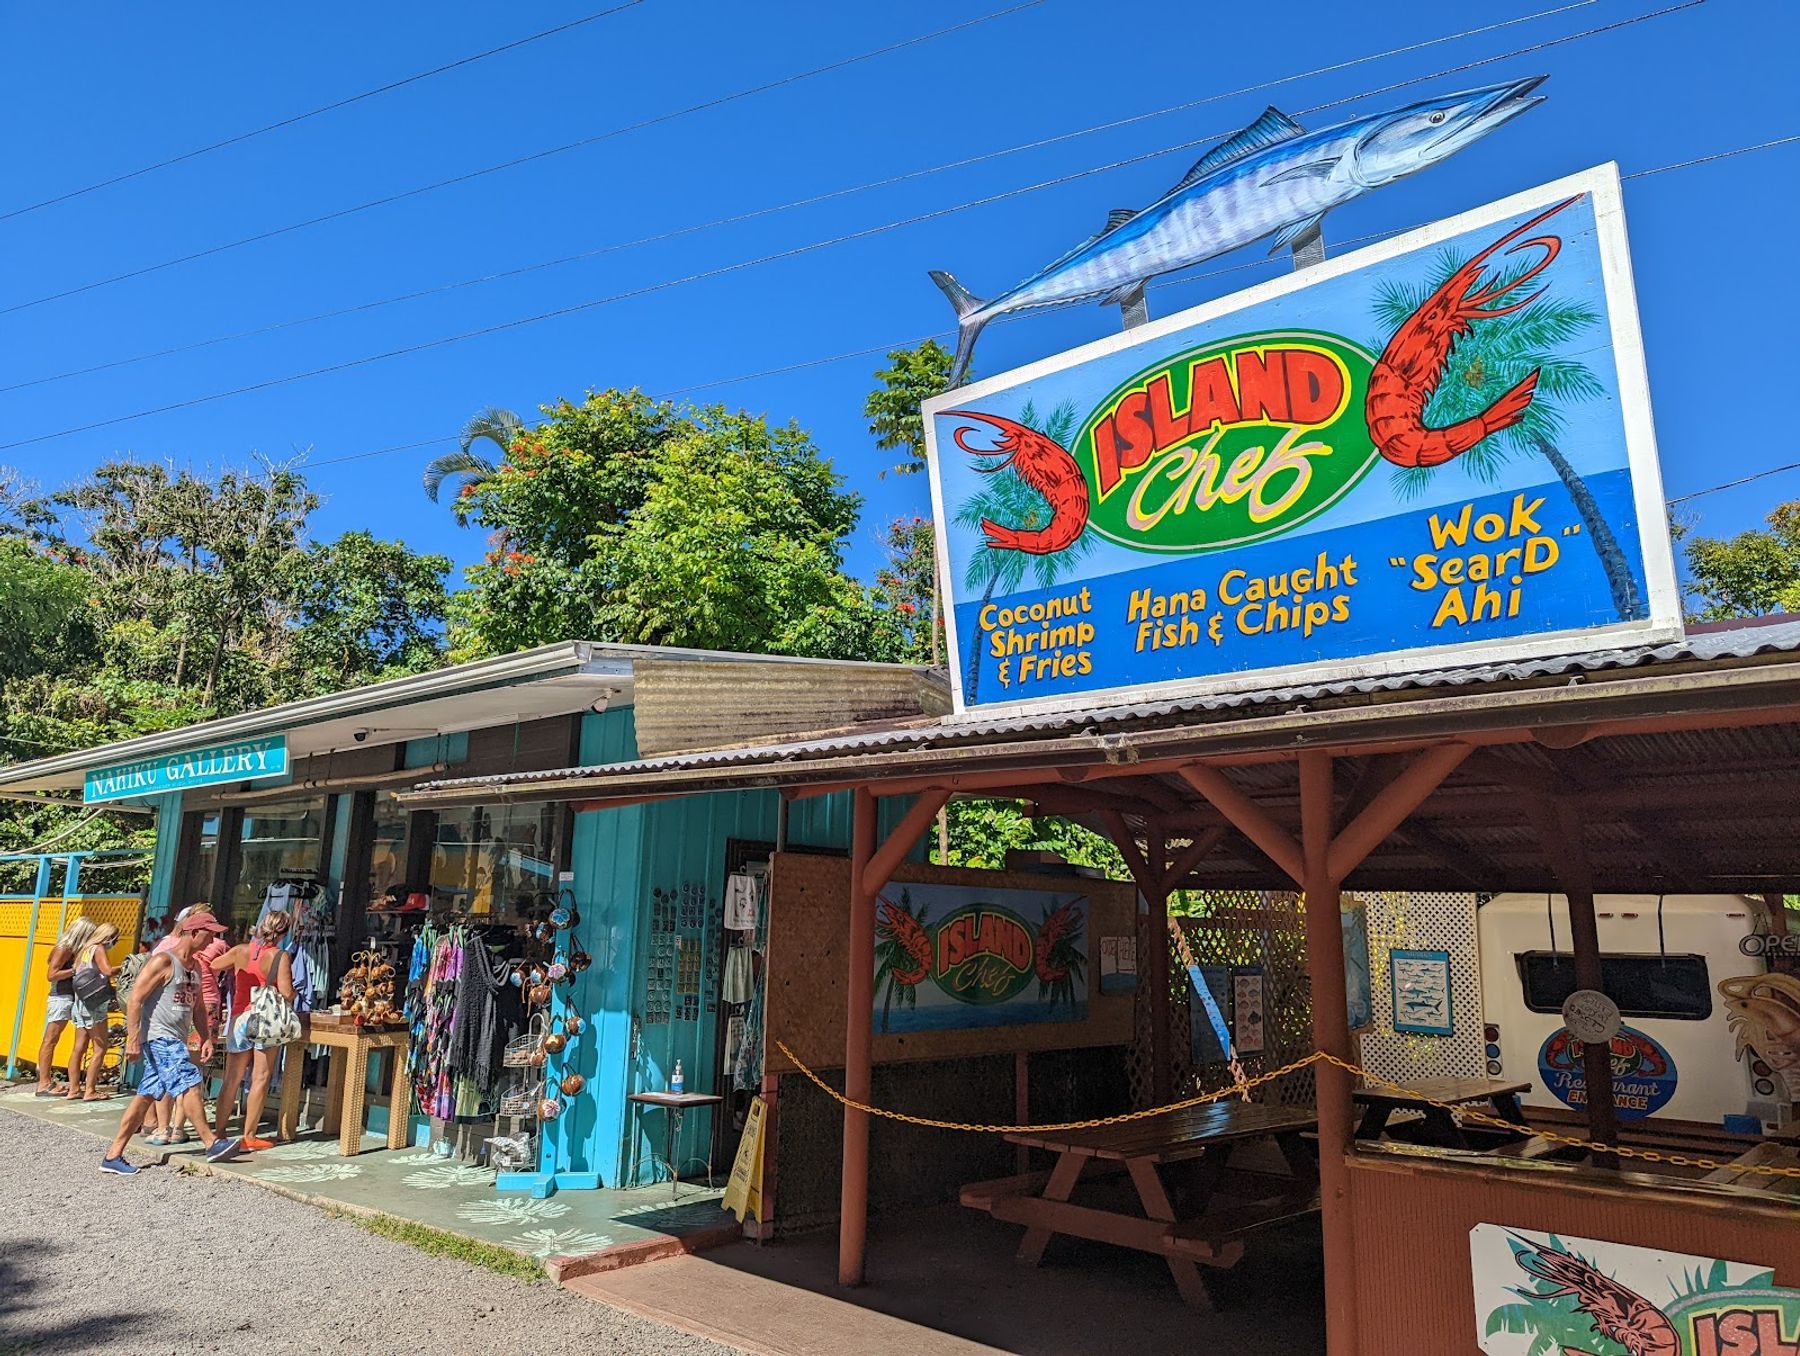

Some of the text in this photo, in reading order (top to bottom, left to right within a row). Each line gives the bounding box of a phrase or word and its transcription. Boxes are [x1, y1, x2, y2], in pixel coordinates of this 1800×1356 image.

[1092, 346, 1349, 500] ISLAND
[1126, 426, 1333, 531] Chef
[979, 586, 1093, 631] Coconut
[1126, 587, 1207, 623] Hana
[1135, 593, 1352, 652] Fish & Chips
[1429, 575, 1523, 628] Ahi
[989, 621, 1095, 658] Shrimp
[998, 649, 1093, 690] & Fries
[90, 742, 272, 798] NAHIKU GALLERY
[938, 912, 1032, 978] ISLAND
[1738, 934, 1800, 957] OPE
[1691, 1307, 1800, 1356] ISL
